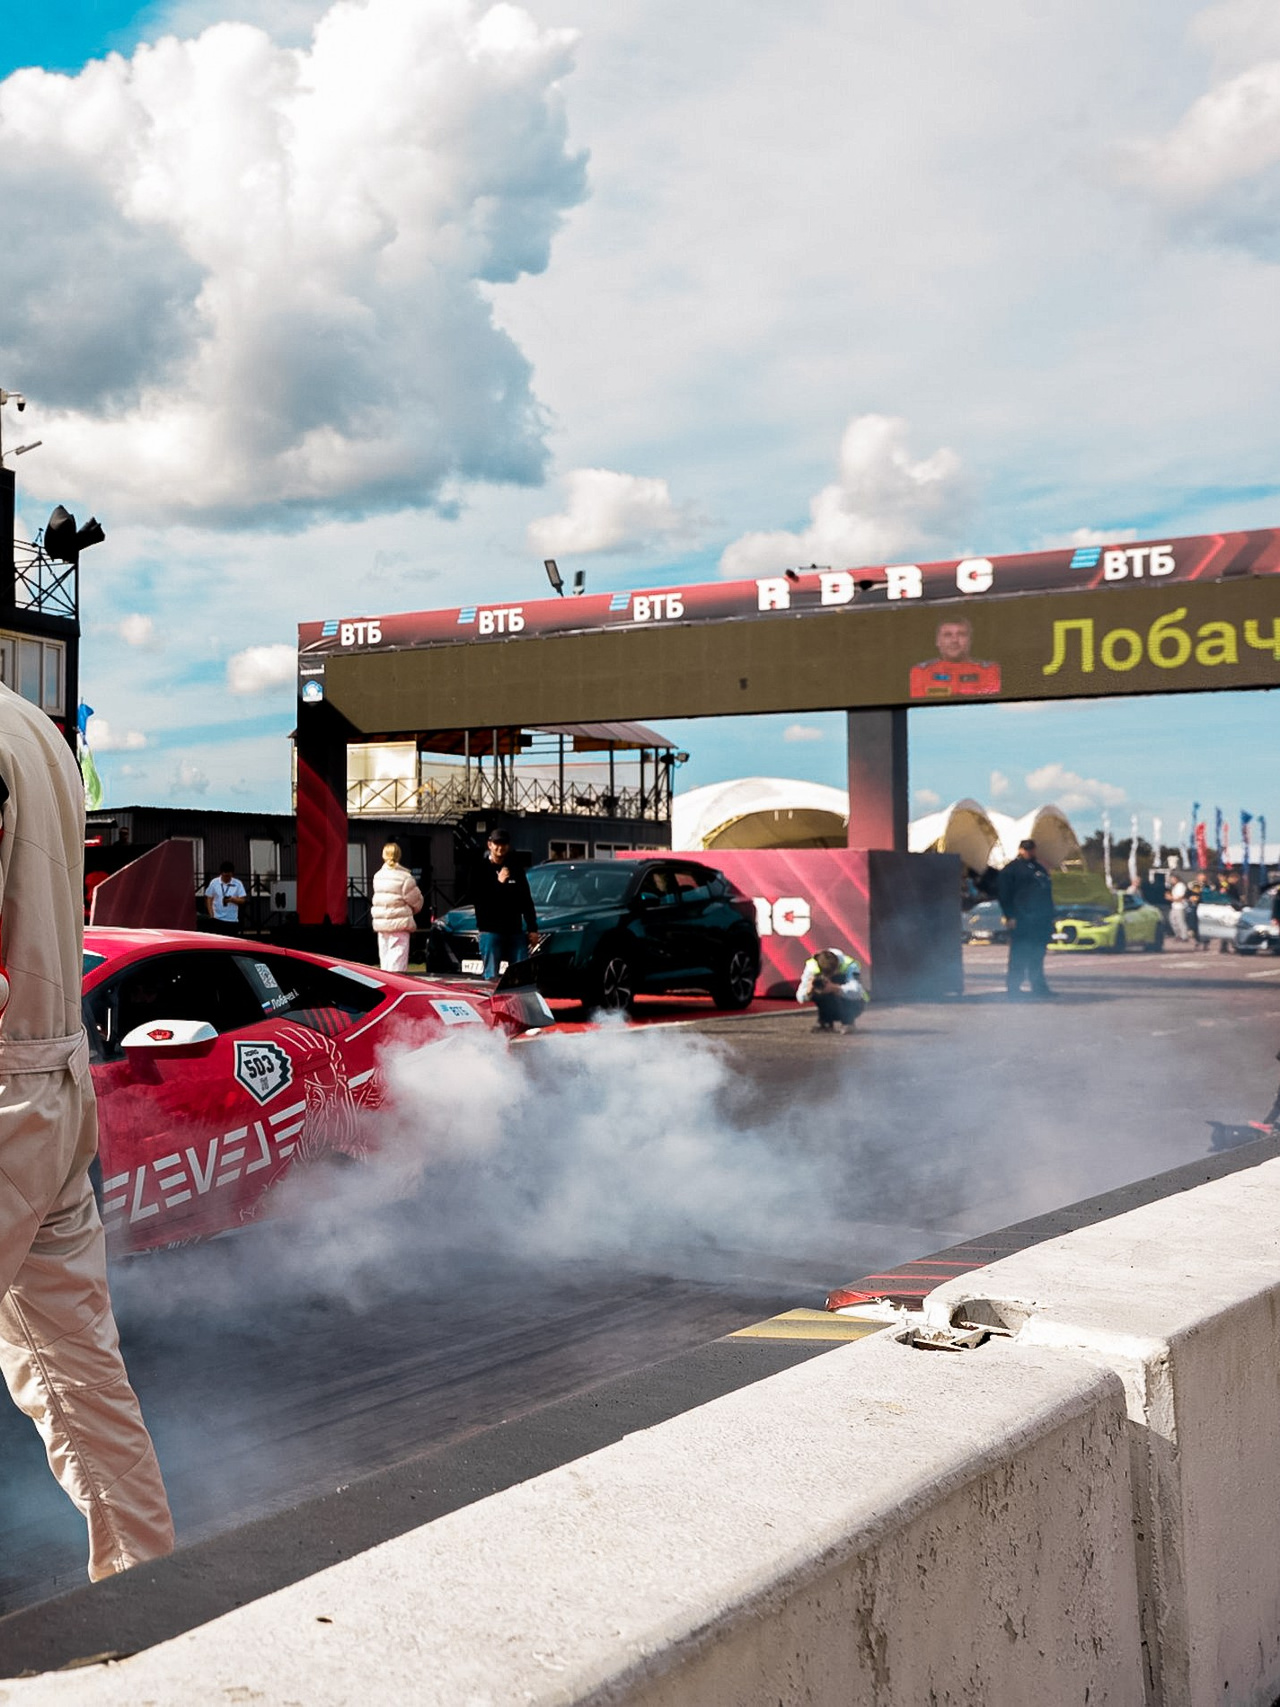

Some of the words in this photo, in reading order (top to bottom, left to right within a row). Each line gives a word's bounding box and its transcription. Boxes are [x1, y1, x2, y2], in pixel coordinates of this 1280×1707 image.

[1103, 544, 1176, 581] ВТБ
[479, 608, 525, 634] ВТБ
[633, 593, 684, 622] ВТБ
[340, 621, 382, 646] ВТБ
[1042, 607, 1280, 676] Лобач
[243, 1054, 275, 1079] 503
